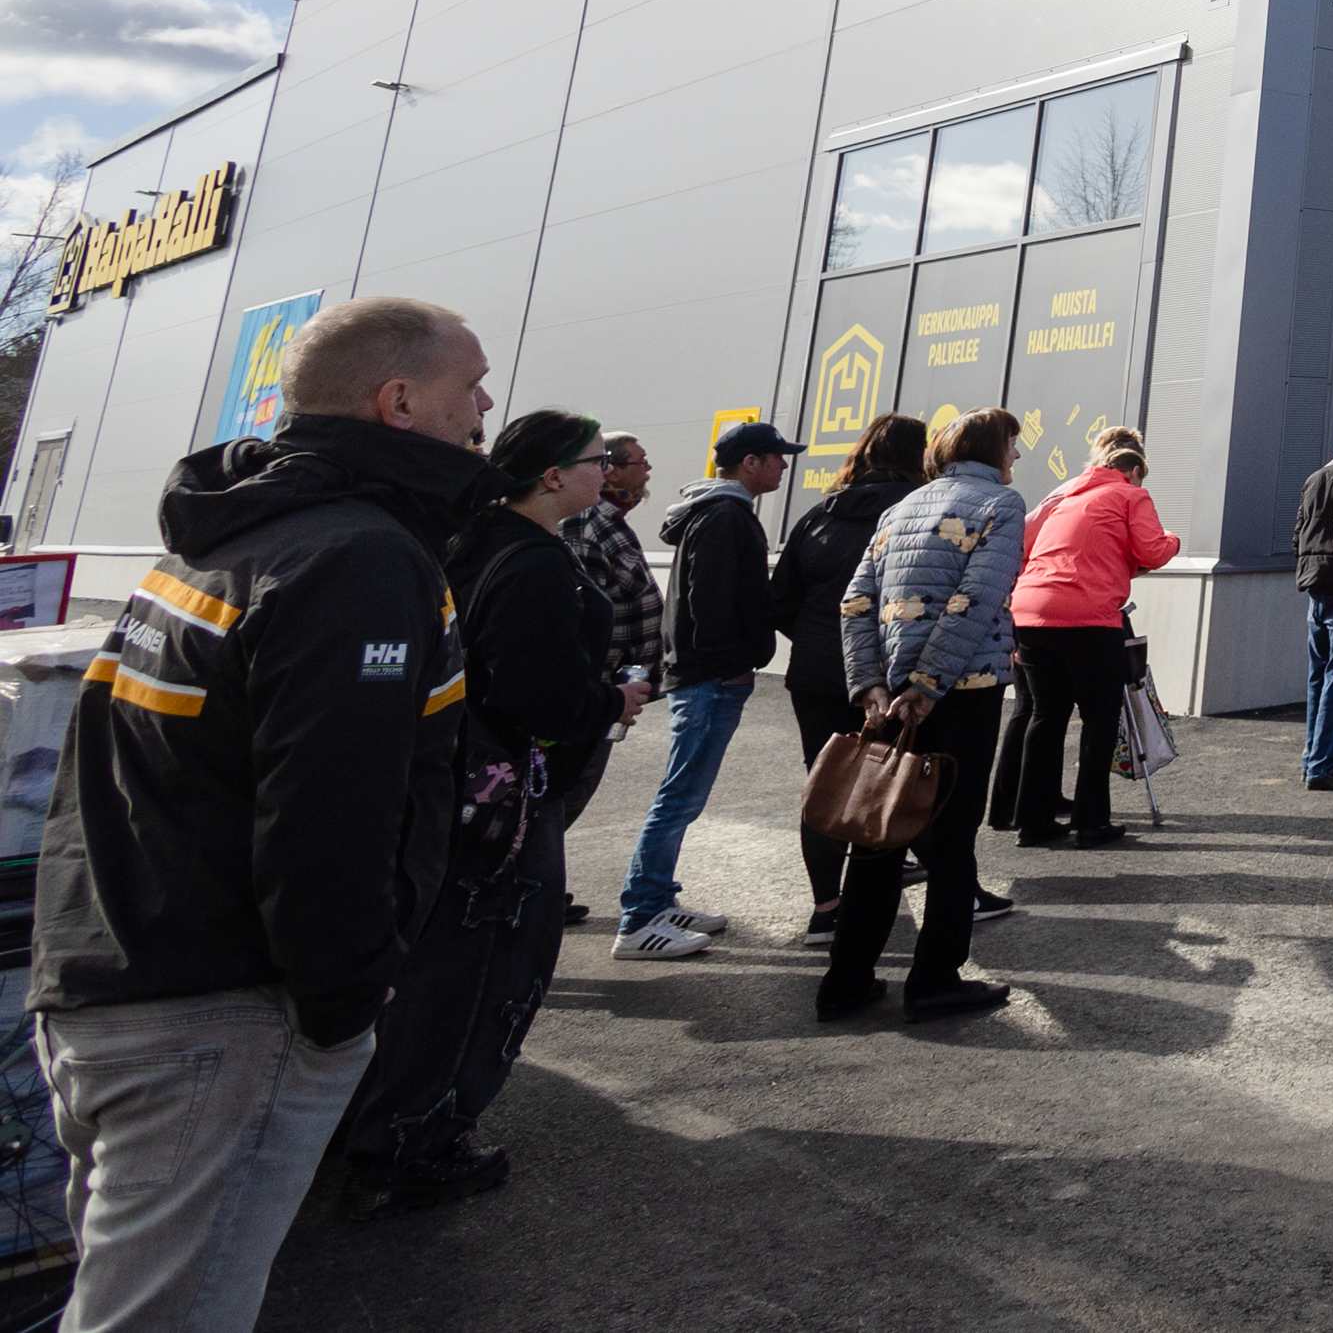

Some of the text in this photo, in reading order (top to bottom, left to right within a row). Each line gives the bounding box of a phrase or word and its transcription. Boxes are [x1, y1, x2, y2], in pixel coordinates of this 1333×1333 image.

[77, 161, 230, 299] HalpaHalli
[917, 302, 1000, 336] VERKKOKAUPPA
[1050, 289, 1097, 318] MUISTA
[927, 337, 980, 367] PALVELEE
[1026, 322, 1116, 355] HALPAHALLI.FI
[363, 643, 408, 664] HH
